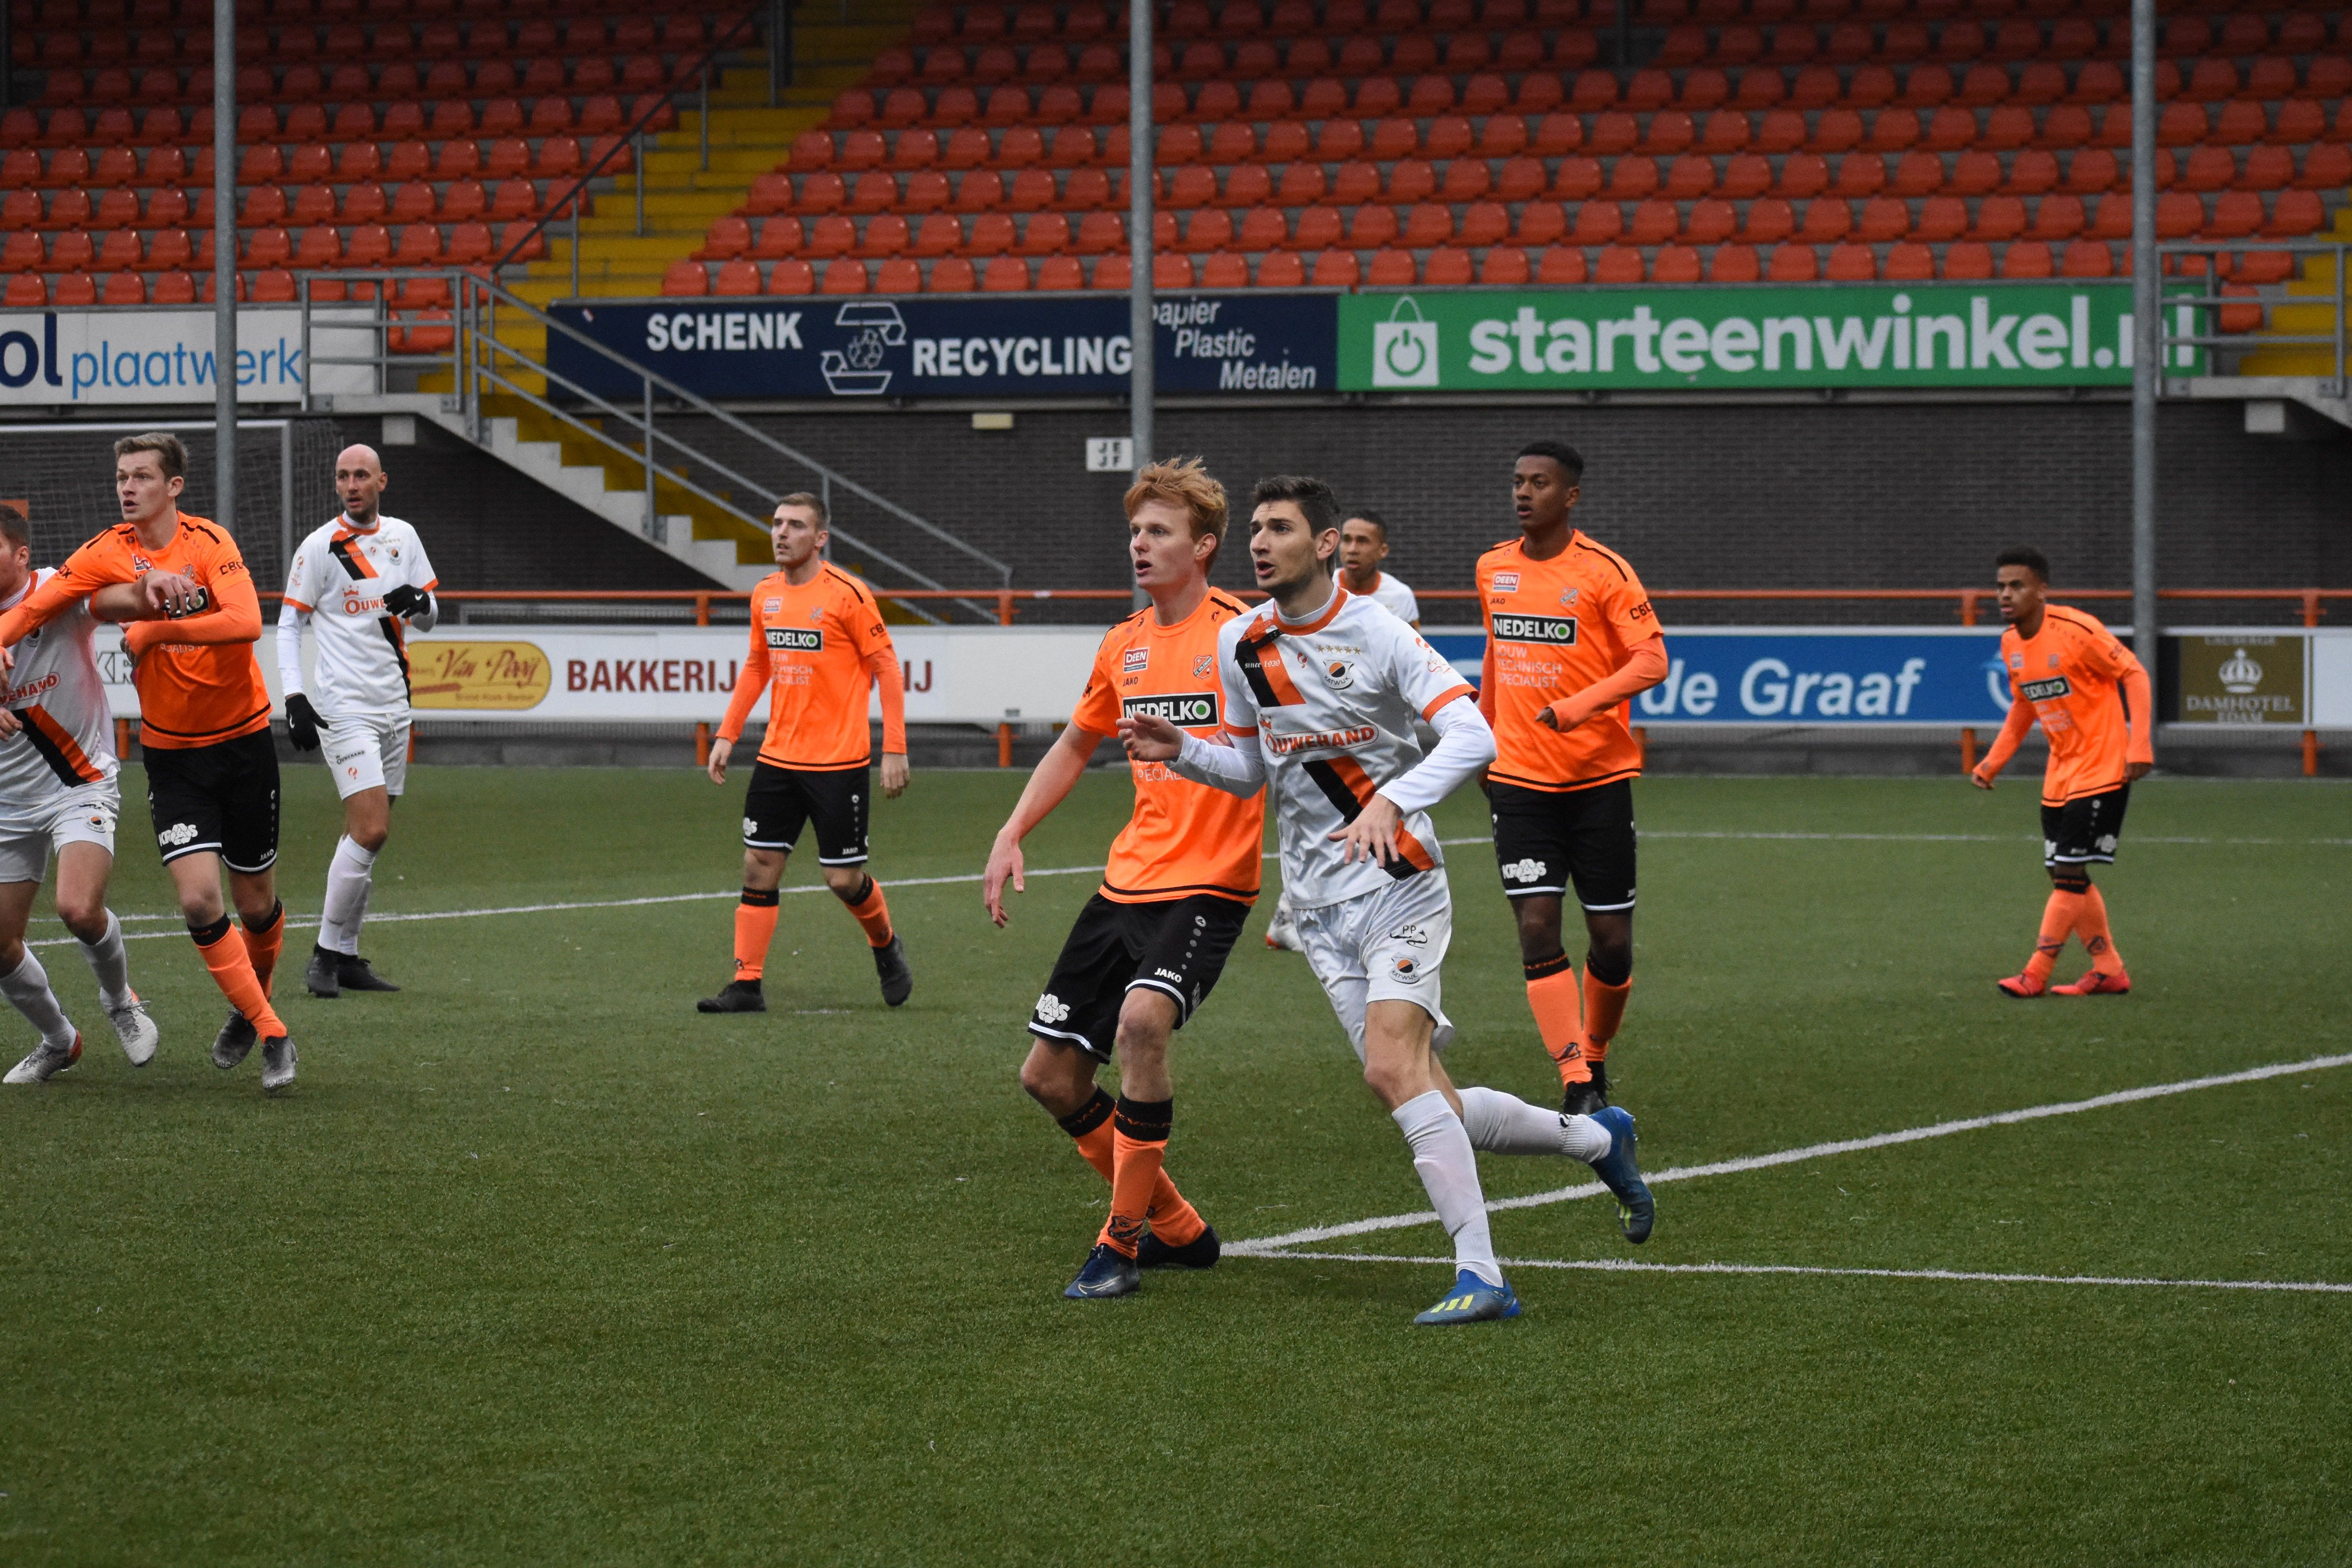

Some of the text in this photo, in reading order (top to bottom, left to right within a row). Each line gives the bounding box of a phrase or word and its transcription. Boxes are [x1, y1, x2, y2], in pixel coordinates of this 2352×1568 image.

[646, 312, 804, 351] SCHENK
[1174, 327, 1256, 358] Plastic
[72, 338, 302, 400] plaatwerk
[913, 336, 1133, 376] RECYCLING
[1220, 360, 1317, 390] Metalen
[345, 598, 386, 614] OUWE
[1494, 618, 1570, 640] NEDELKO
[567, 659, 736, 692] BAKKERIJ
[1639, 658, 1926, 716] de Graaf
[1154, 968, 1182, 983] JAKO
